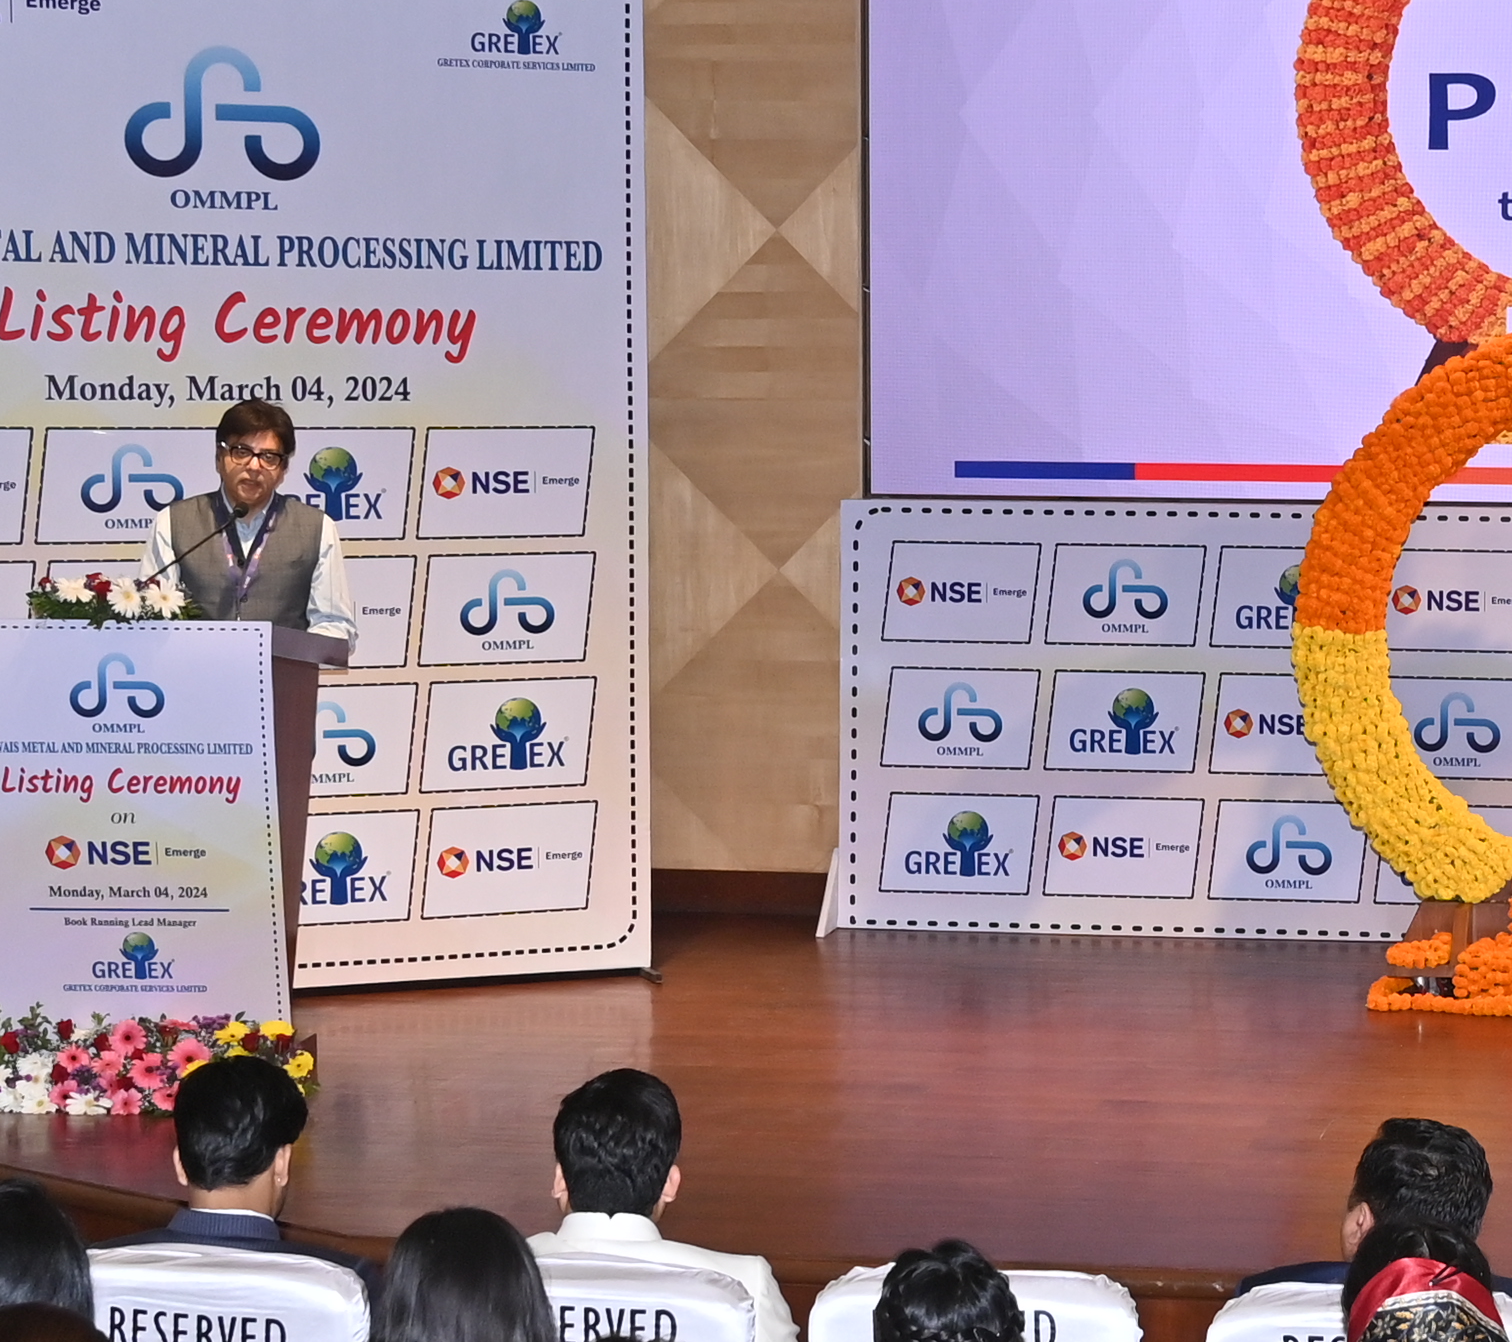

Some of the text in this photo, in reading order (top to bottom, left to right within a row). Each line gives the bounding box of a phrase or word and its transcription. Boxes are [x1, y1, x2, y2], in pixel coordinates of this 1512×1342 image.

[438, 58, 595, 71] GRETEX CORPORATE SERVICES LIMITED
[171, 190, 277, 210] OMMPL
[49, 231, 115, 263] AND
[125, 233, 269, 266] MINERAL
[277, 236, 468, 270] PROCESSING
[476, 240, 602, 271] LIMITED
[215, 291, 476, 363] Ceremony
[45, 375, 410, 408] Monday, March 04, 2024
[472, 471, 579, 494] NSE Emerge
[931, 582, 981, 603] NSE
[1428, 590, 1479, 611] NSE
[92, 723, 145, 733] OMMPL
[22, 742, 59, 753] METAL
[61, 742, 82, 753] AND
[86, 743, 135, 753] MINERAL
[137, 743, 204, 754] PROCESSING
[207, 743, 253, 754] LIMITED
[448, 739, 564, 772] GRETEX
[2, 767, 240, 804] Listing Ceremony
[111, 813, 134, 823] on
[88, 841, 206, 865] NSE Emerge
[1093, 837, 1144, 858] NSE
[476, 848, 533, 872] NSE
[904, 851, 1010, 878] GRETEX
[49, 886, 207, 900] Monday, March 04, 2024
[91, 918, 129, 928] Running
[132, 918, 154, 926] Lead
[157, 918, 196, 928] Manager
